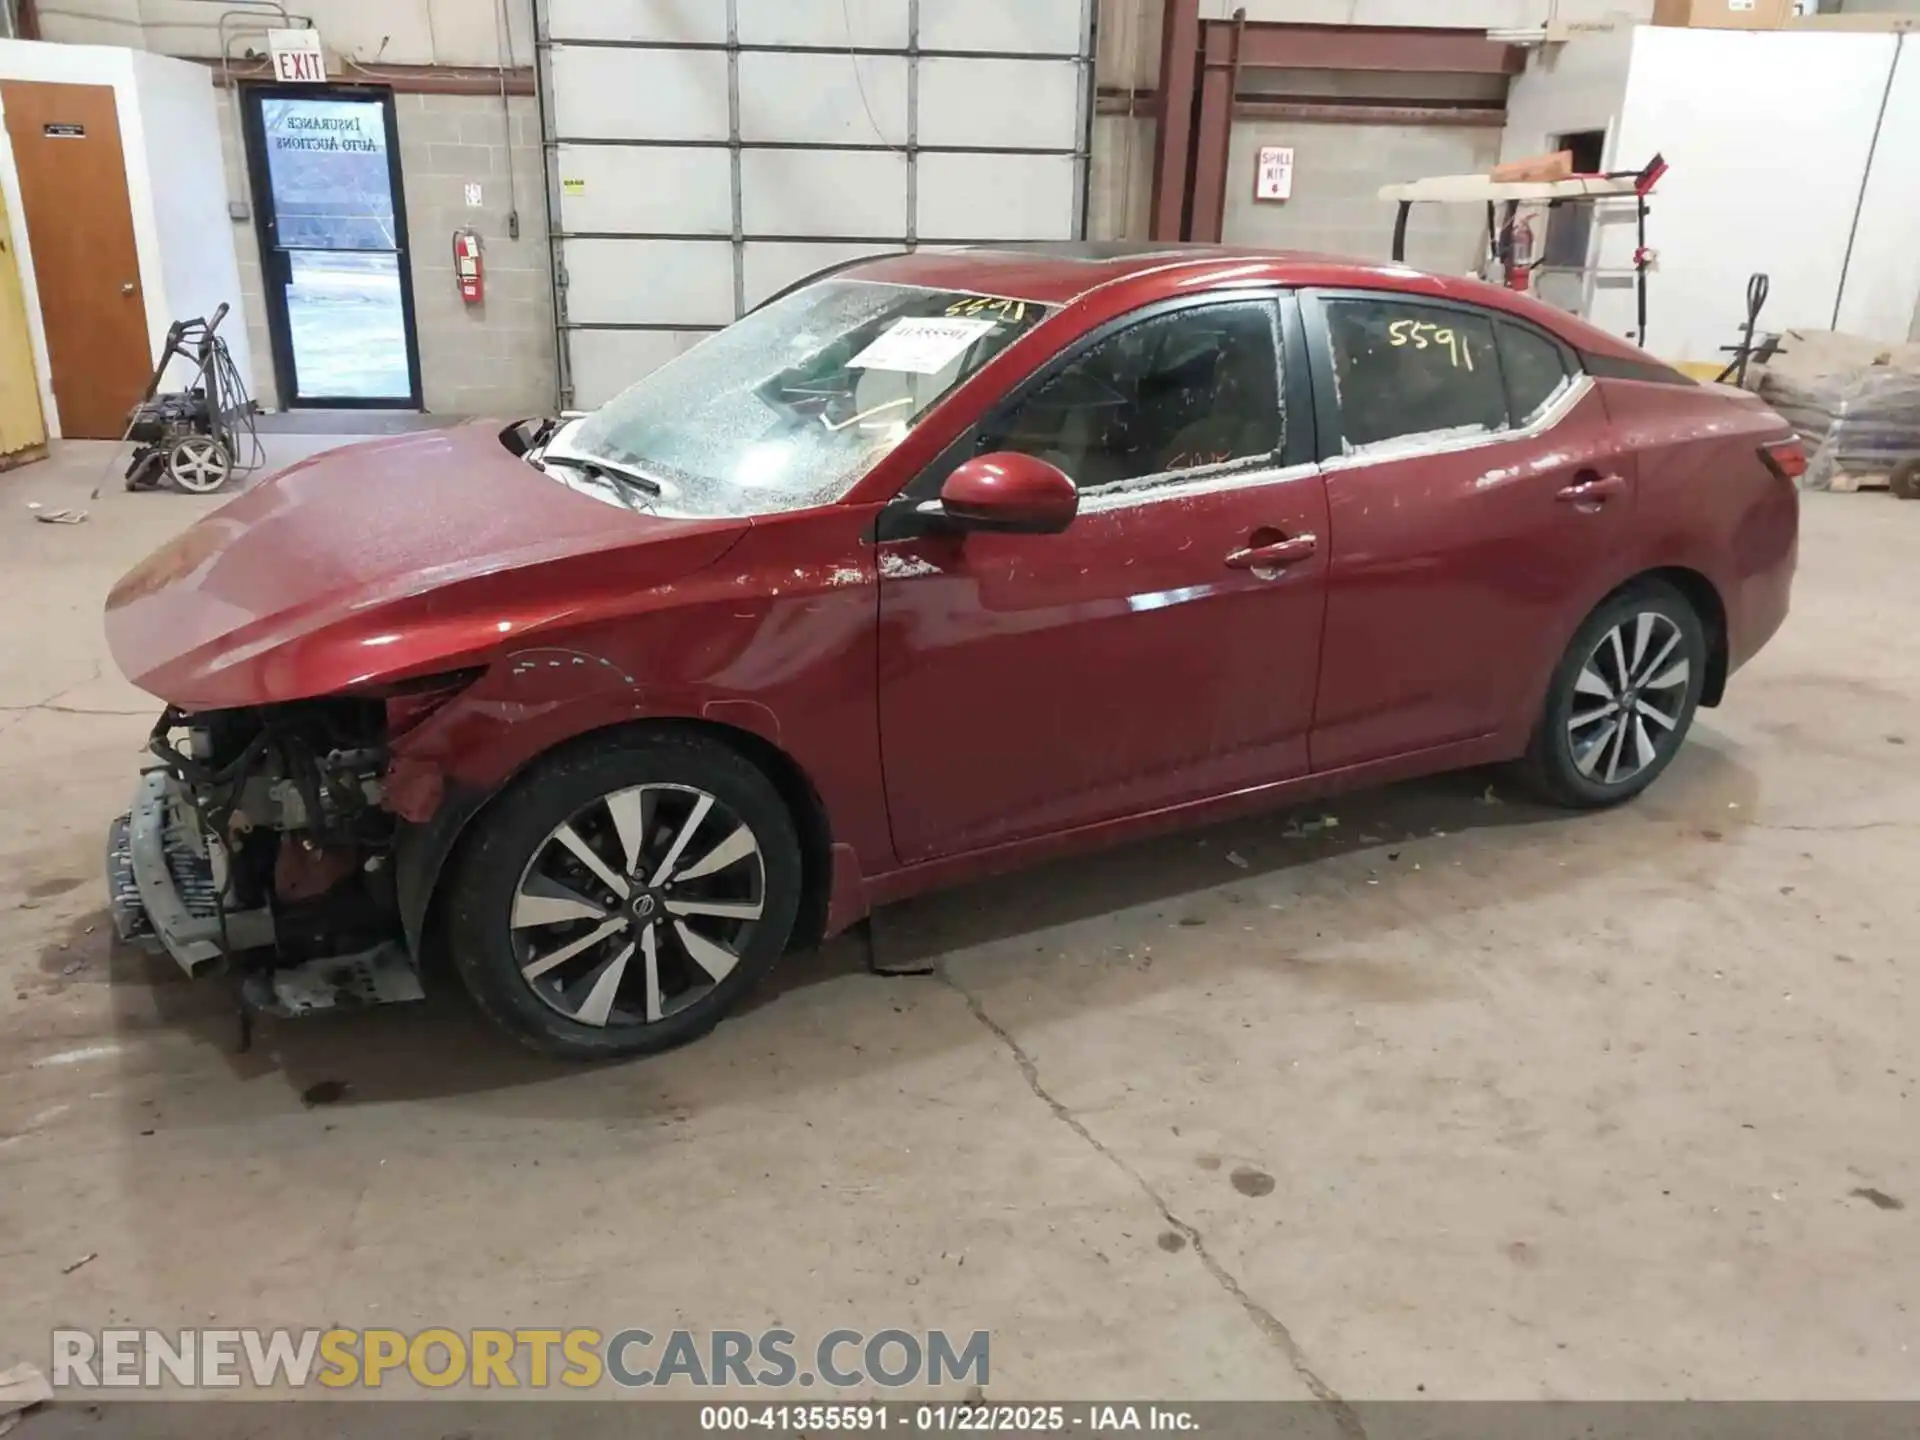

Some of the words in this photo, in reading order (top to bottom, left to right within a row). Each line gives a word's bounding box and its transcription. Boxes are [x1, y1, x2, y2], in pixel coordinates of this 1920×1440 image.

[278, 53, 322, 80] EXIT
[1262, 152, 1291, 165] SPILL
[1267, 167, 1285, 180] KIT
[1388, 319, 1474, 372] 5591
